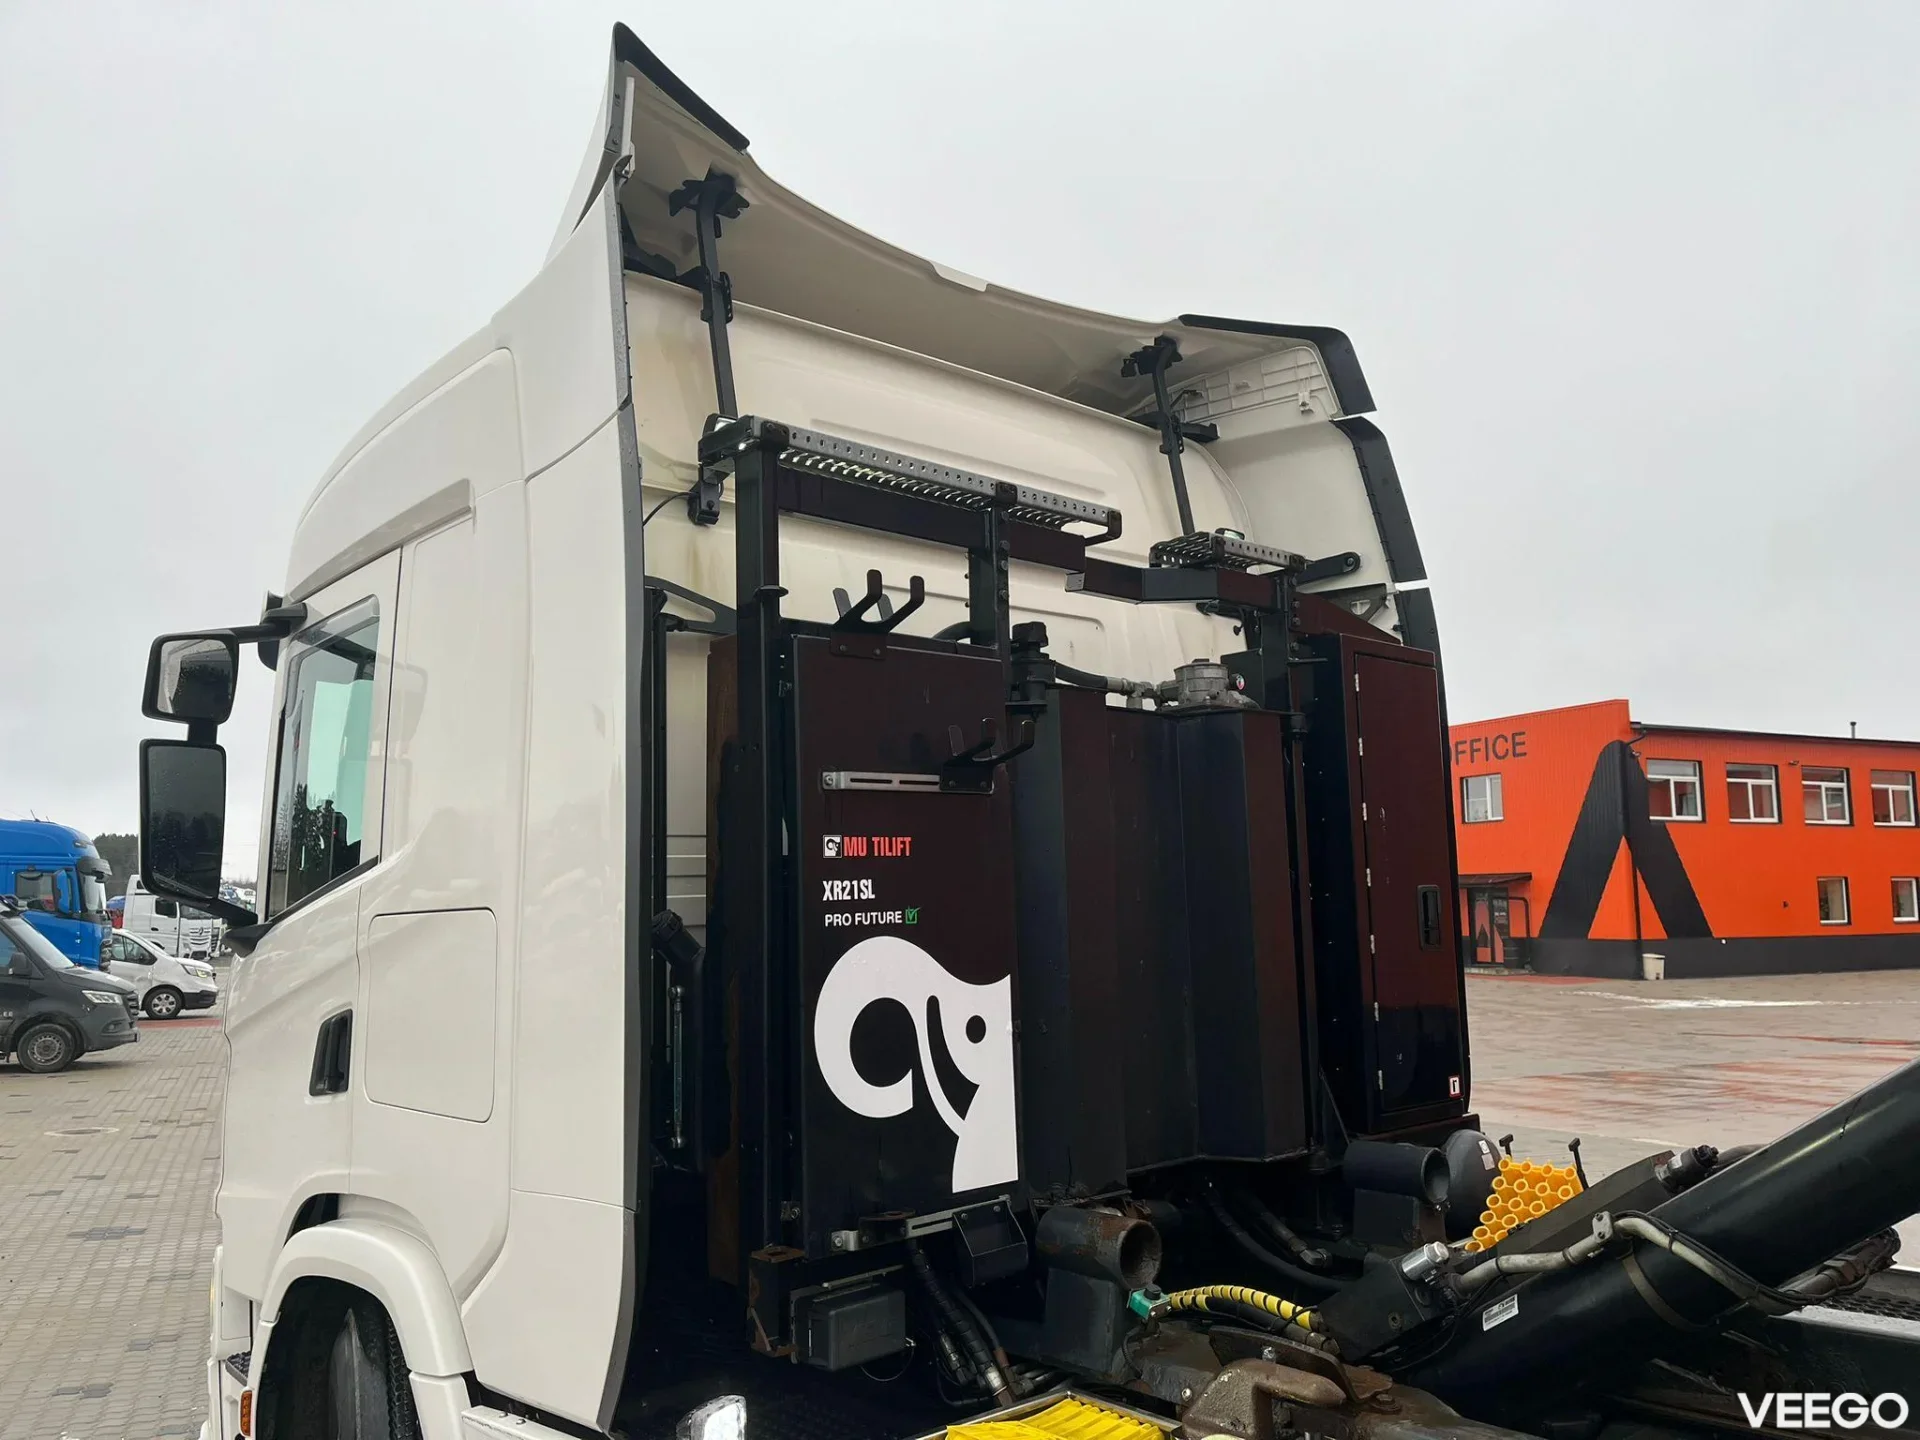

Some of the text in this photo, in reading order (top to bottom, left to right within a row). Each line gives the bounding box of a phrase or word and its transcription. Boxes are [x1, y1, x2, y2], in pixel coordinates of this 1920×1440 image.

[1450, 732, 1527, 766] FFICE
[822, 879, 875, 901] XR21SL
[824, 911, 902, 927] PRO FUTURE
